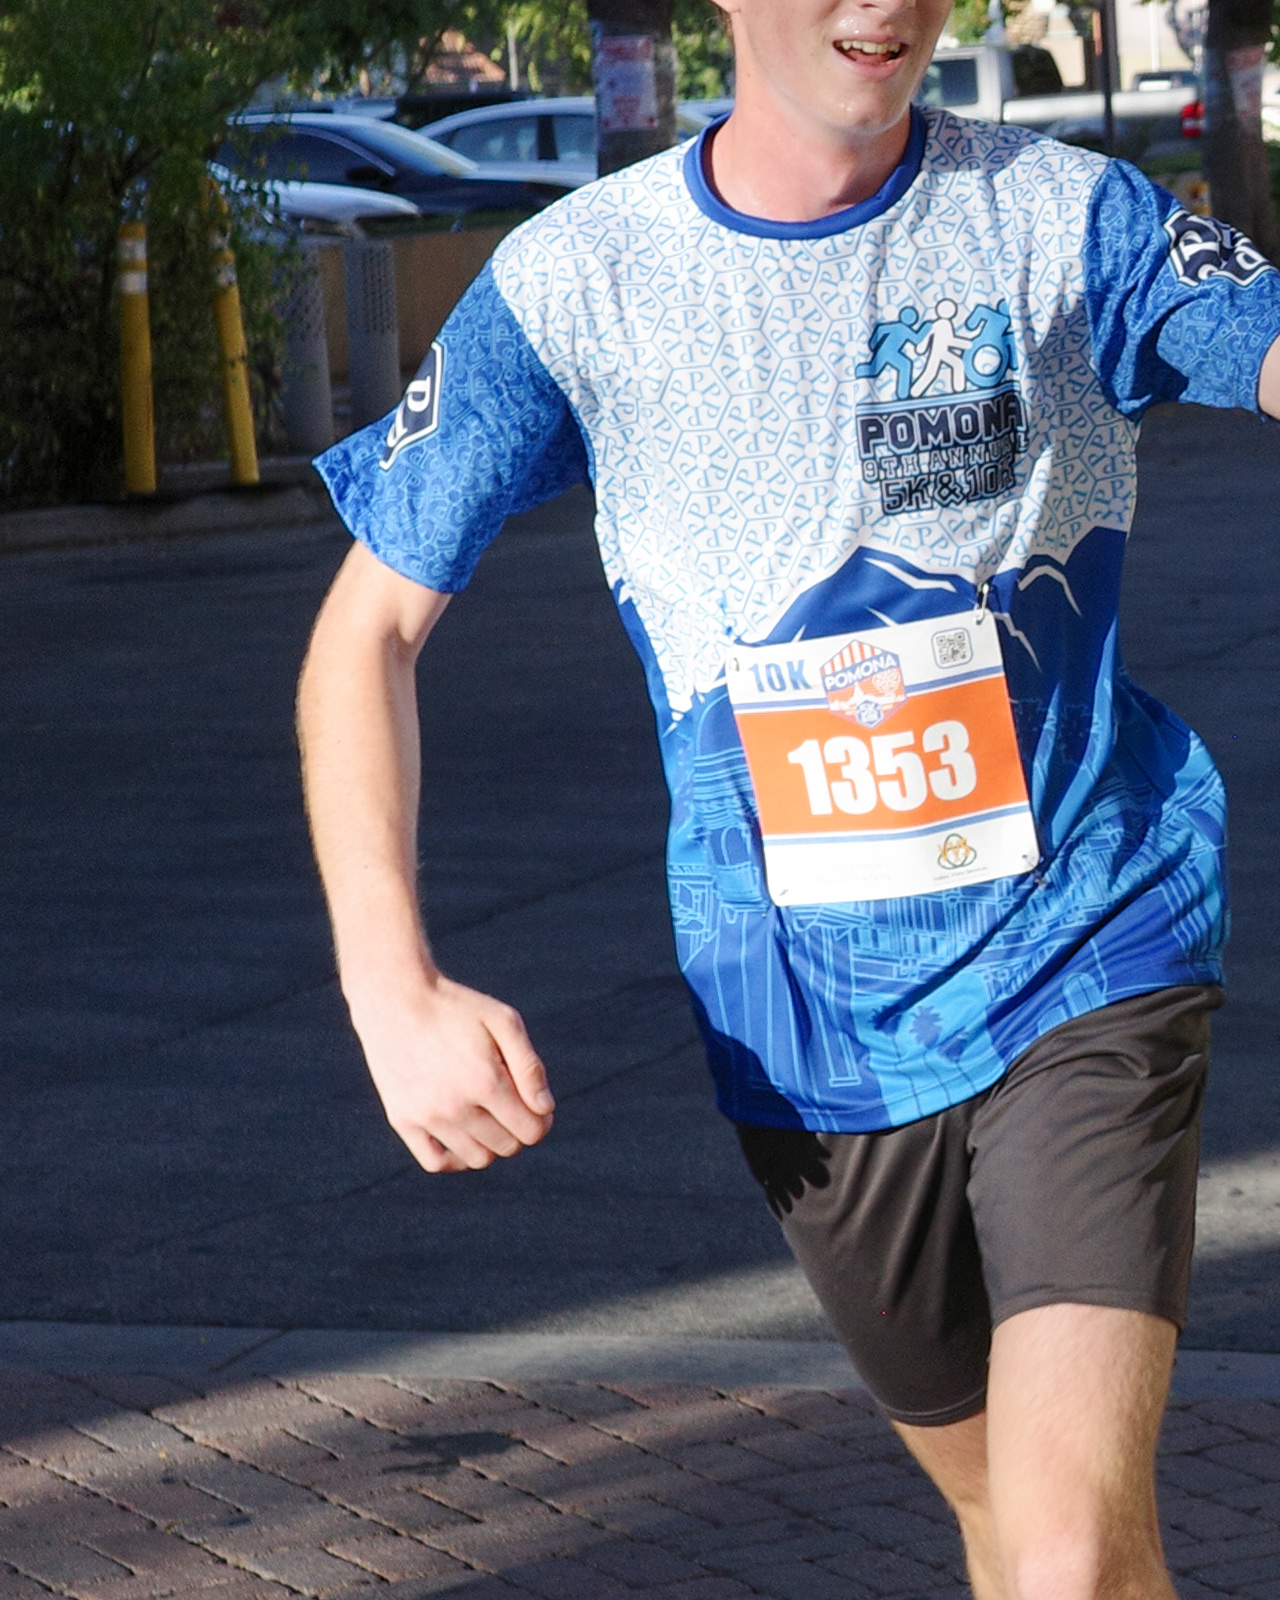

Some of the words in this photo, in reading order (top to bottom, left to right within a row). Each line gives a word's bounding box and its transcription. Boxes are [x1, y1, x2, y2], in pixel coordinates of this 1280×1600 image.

[857, 391, 1027, 459] POMONA
[863, 453, 920, 482] 9TH
[882, 476, 933, 514] 5K
[935, 471, 964, 505] &
[748, 659, 812, 692] 10K
[824, 654, 897, 690] POMONA
[787, 720, 977, 815] 1353
